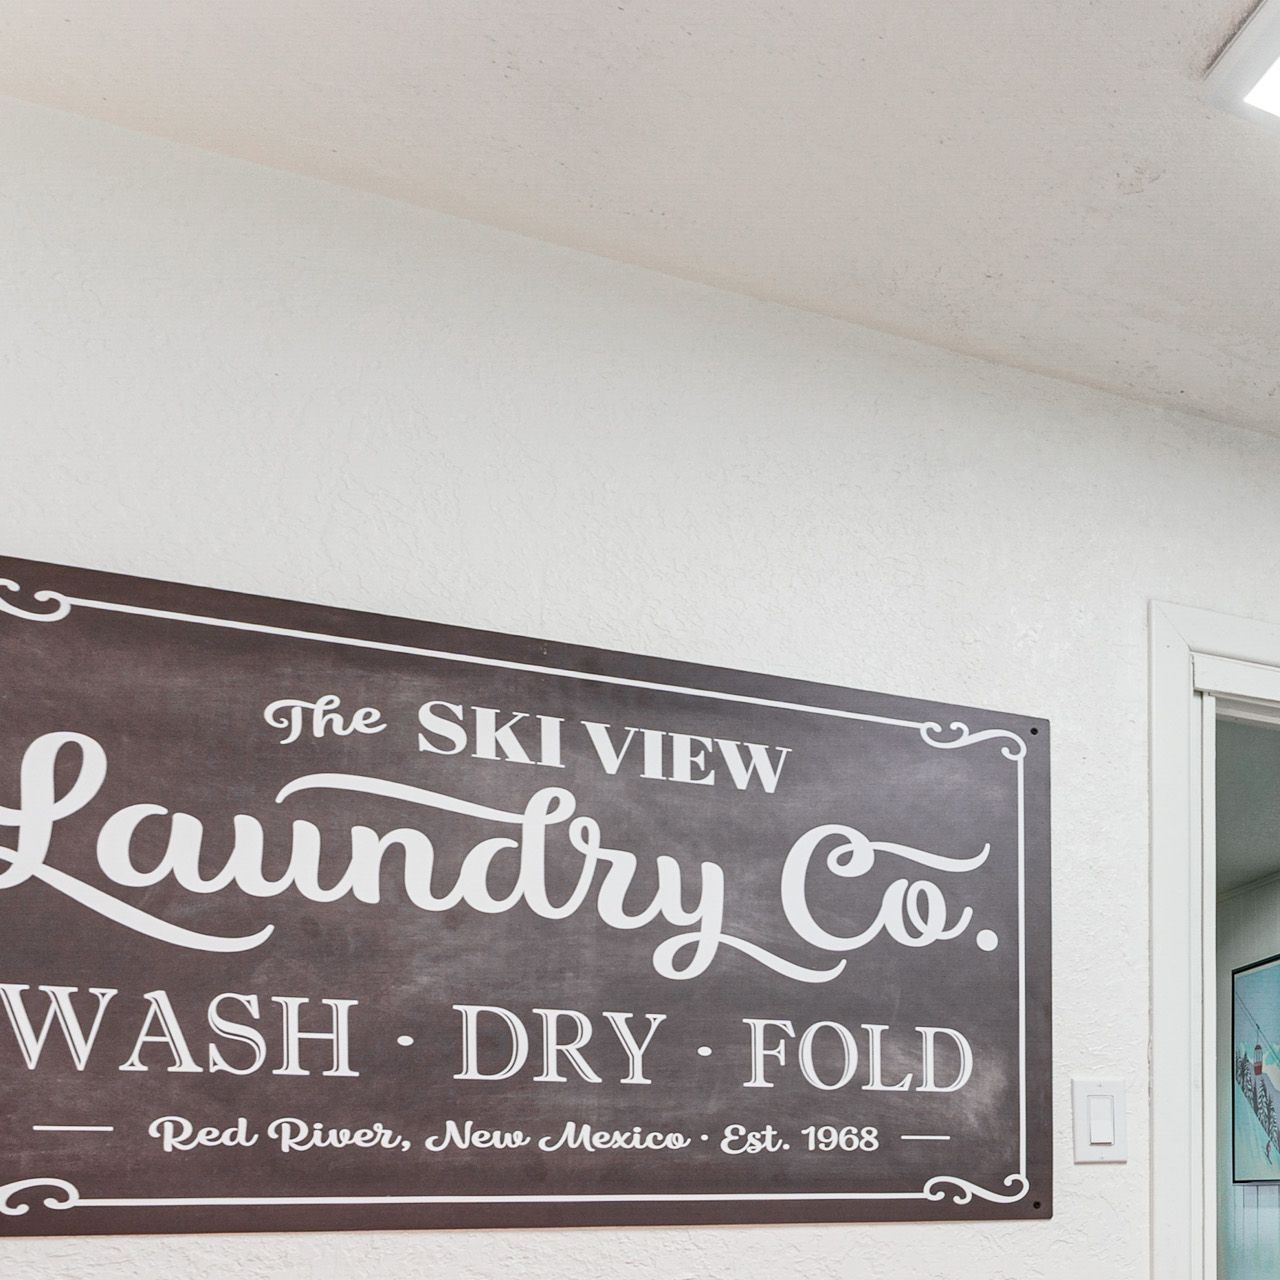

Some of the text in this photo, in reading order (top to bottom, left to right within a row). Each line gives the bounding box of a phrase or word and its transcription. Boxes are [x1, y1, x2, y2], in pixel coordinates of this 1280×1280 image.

[264, 694, 793, 796] The SKI VIEW
[0, 730, 999, 984] Laundry Co.
[0, 983, 974, 1093] WASH DRY FOLD
[149, 1116, 880, 1154] Red River, New Mexico Est. 1968
